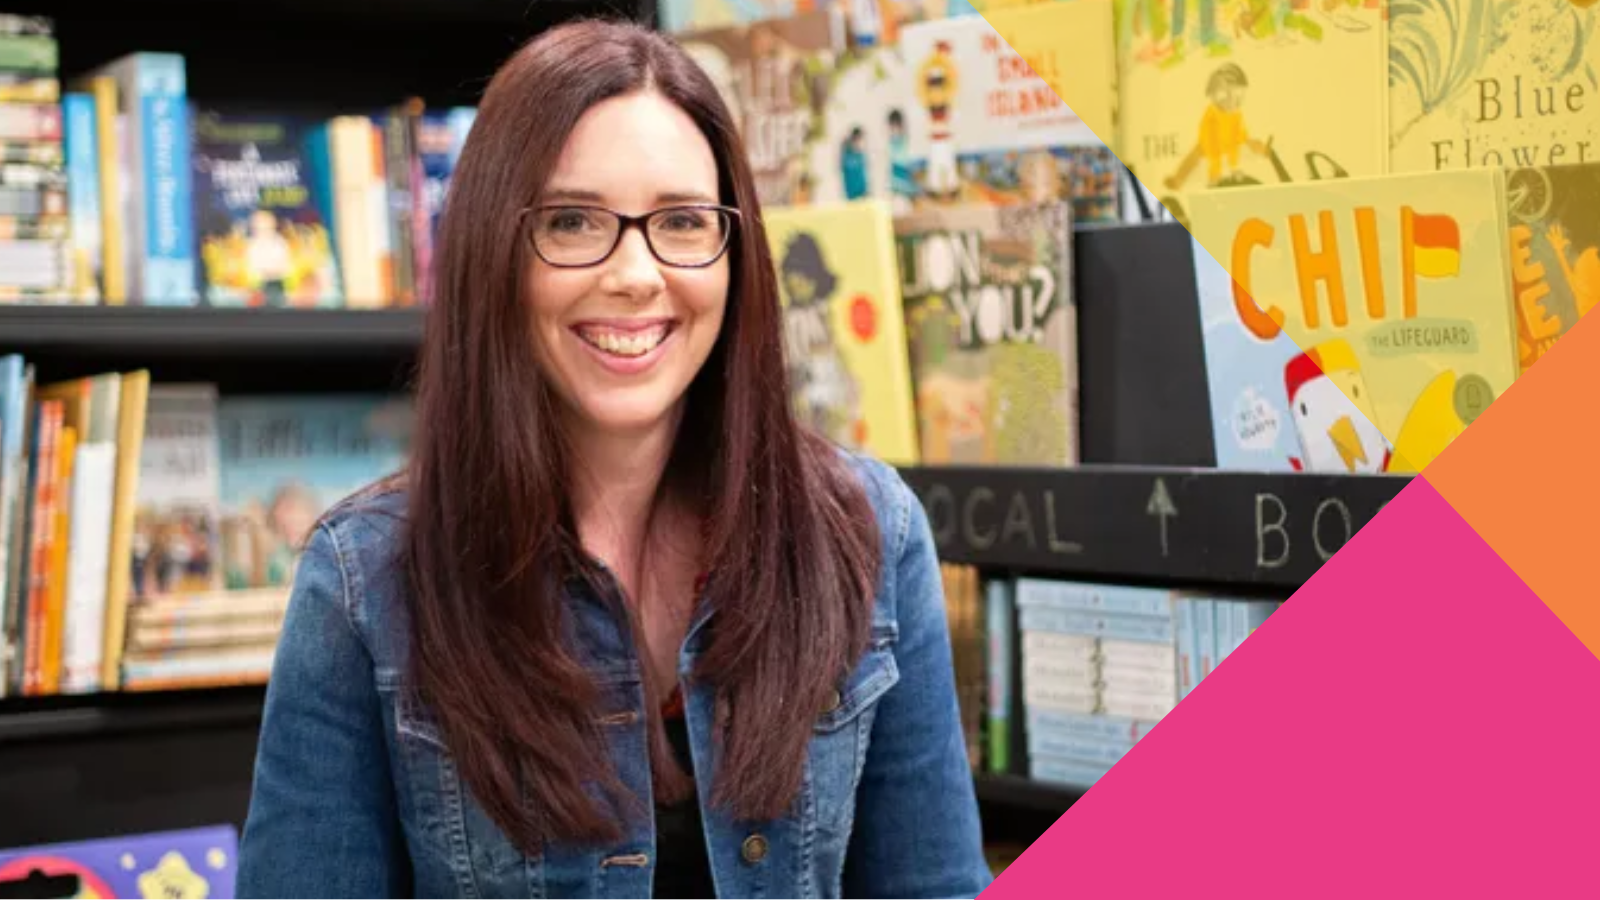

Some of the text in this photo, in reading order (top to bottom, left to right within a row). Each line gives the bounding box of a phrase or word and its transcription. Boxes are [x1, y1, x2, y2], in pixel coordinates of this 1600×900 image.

[986, 82, 1062, 117] ISLAND
[1475, 75, 1585, 122] Blue
[1143, 135, 1177, 161] THE
[1431, 139, 1591, 171] Flower
[1231, 205, 1461, 341] CHIP
[950, 264, 1055, 345] YOU?
[1371, 326, 1470, 348] THE LIFEGUARD
[1255, 492, 1391, 569] BO
